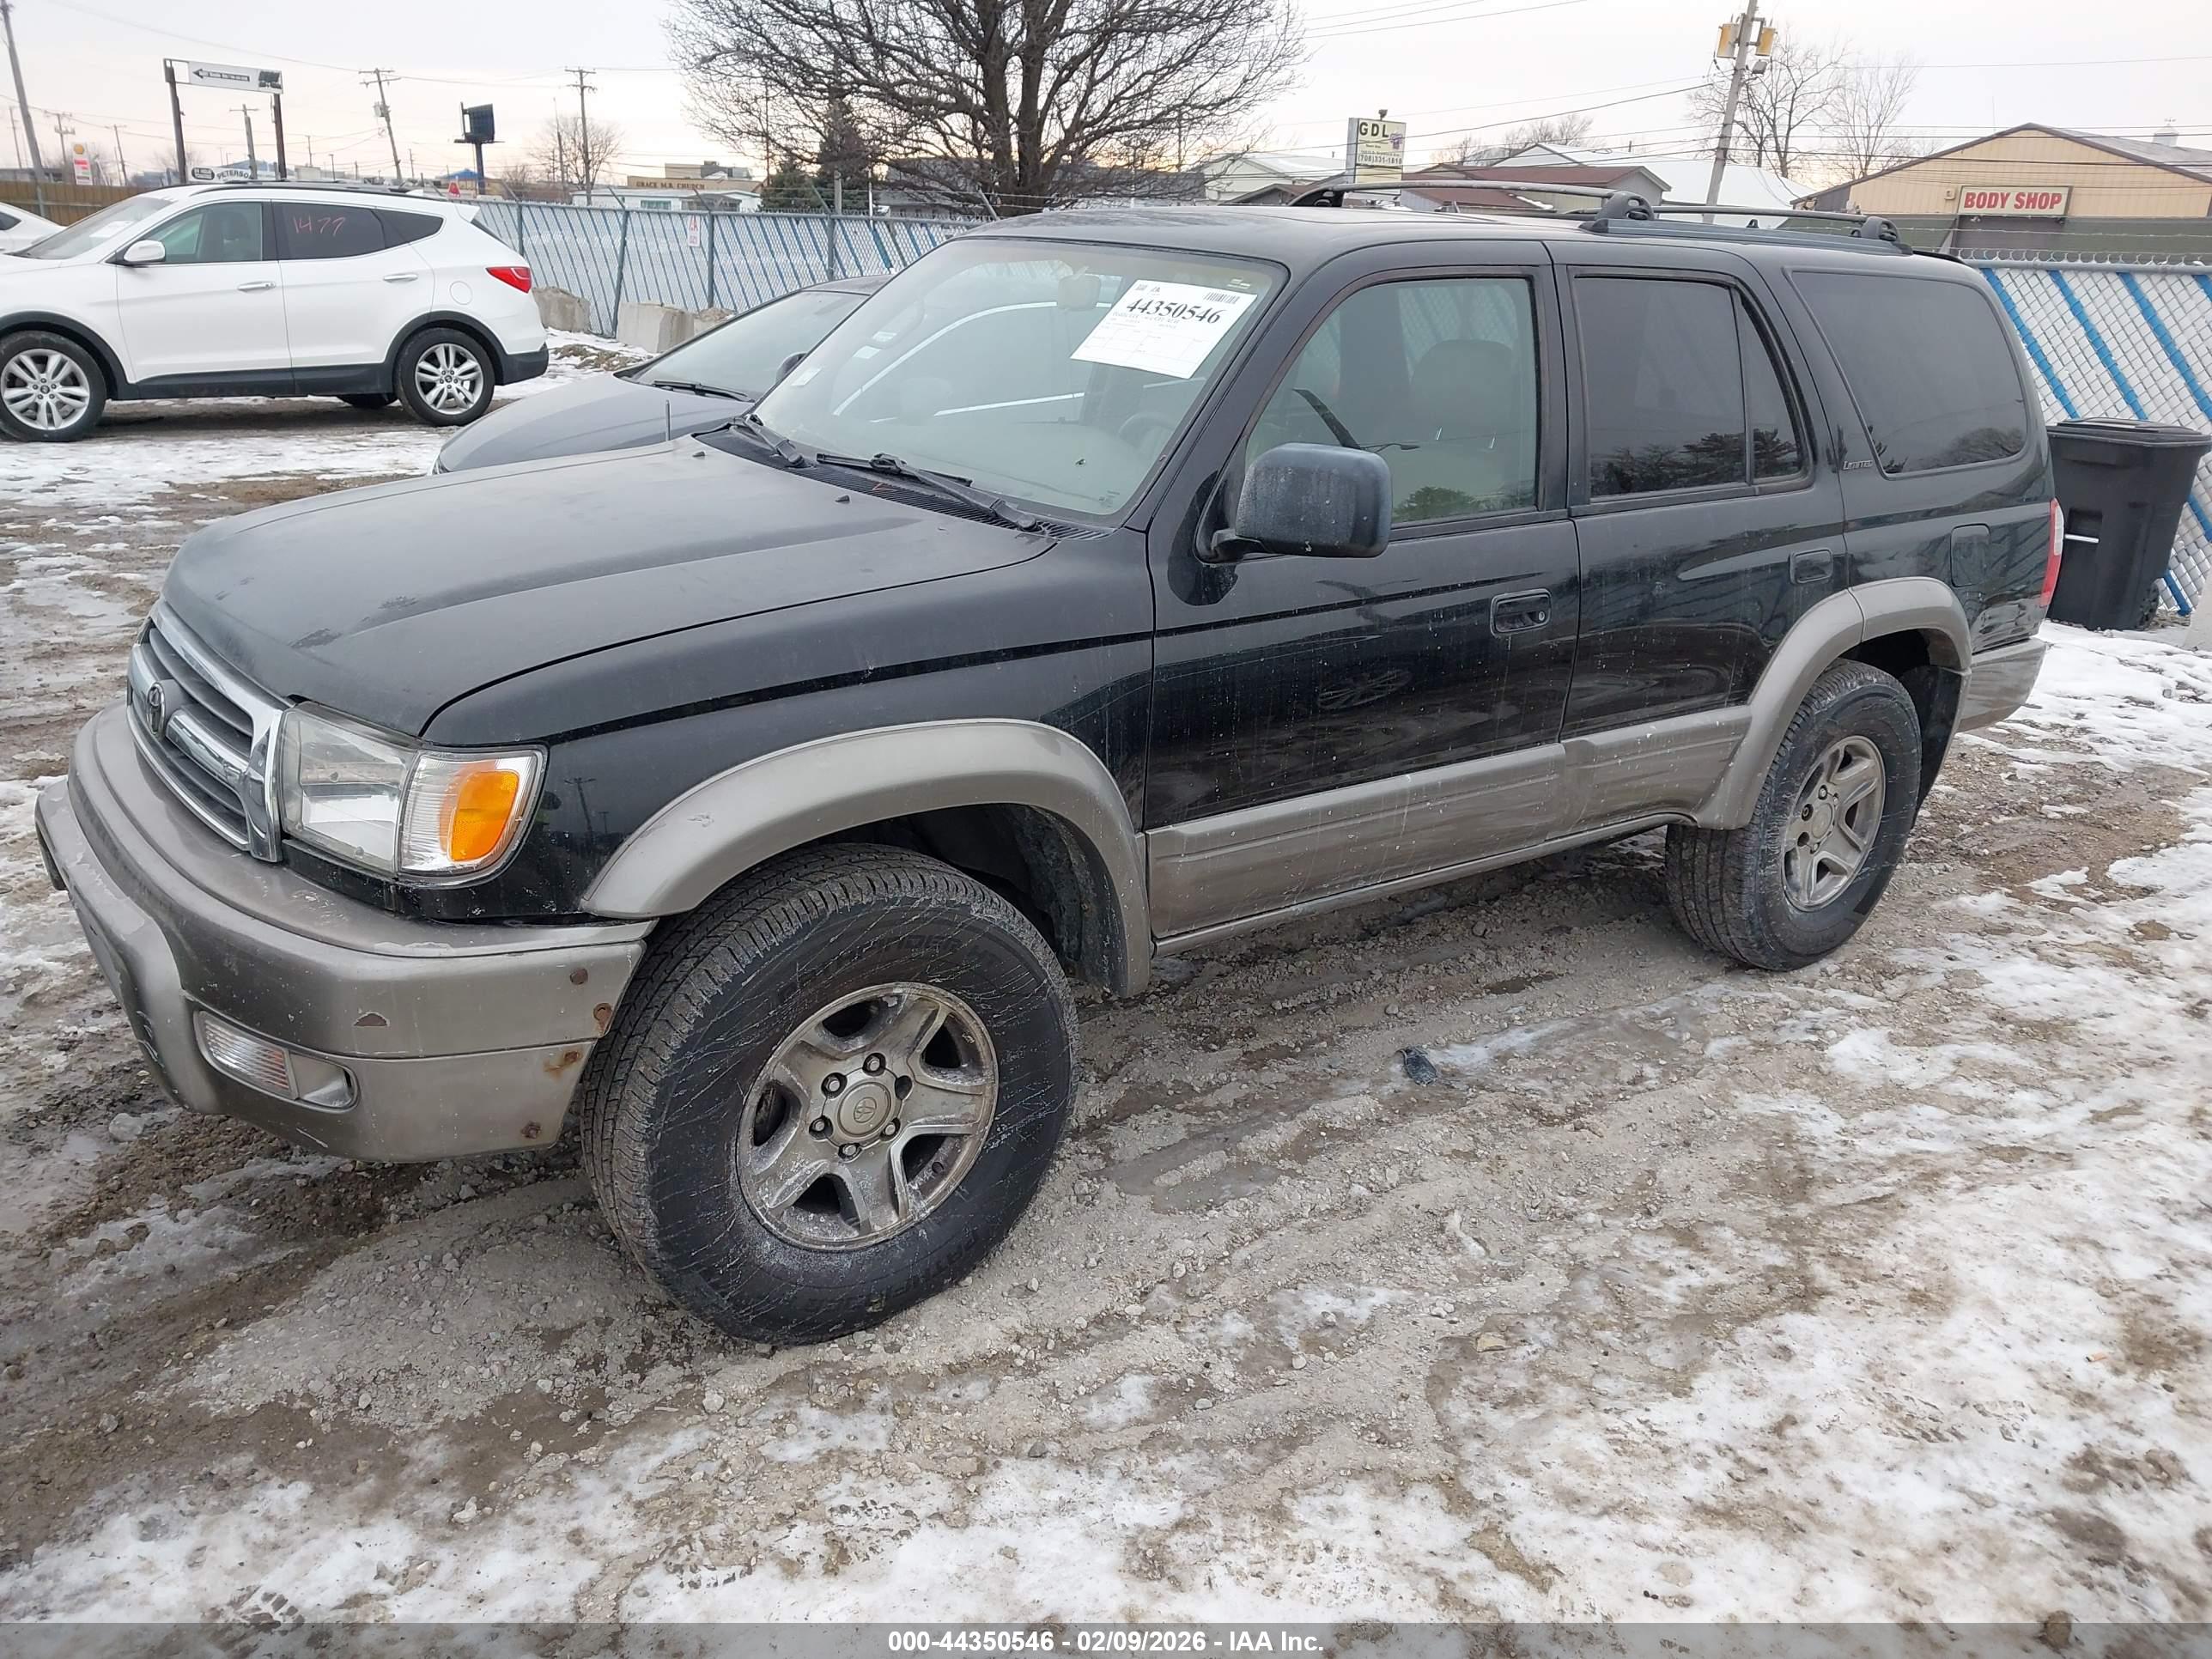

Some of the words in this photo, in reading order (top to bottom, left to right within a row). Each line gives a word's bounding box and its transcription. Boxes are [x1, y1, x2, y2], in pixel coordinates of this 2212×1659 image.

[1359, 122, 1389, 138] GDL
[1963, 191, 2011, 209] BODY
[2014, 191, 2062, 210] SHOP
[293, 216, 346, 237] 1477
[1126, 298, 1227, 324] 44350546
